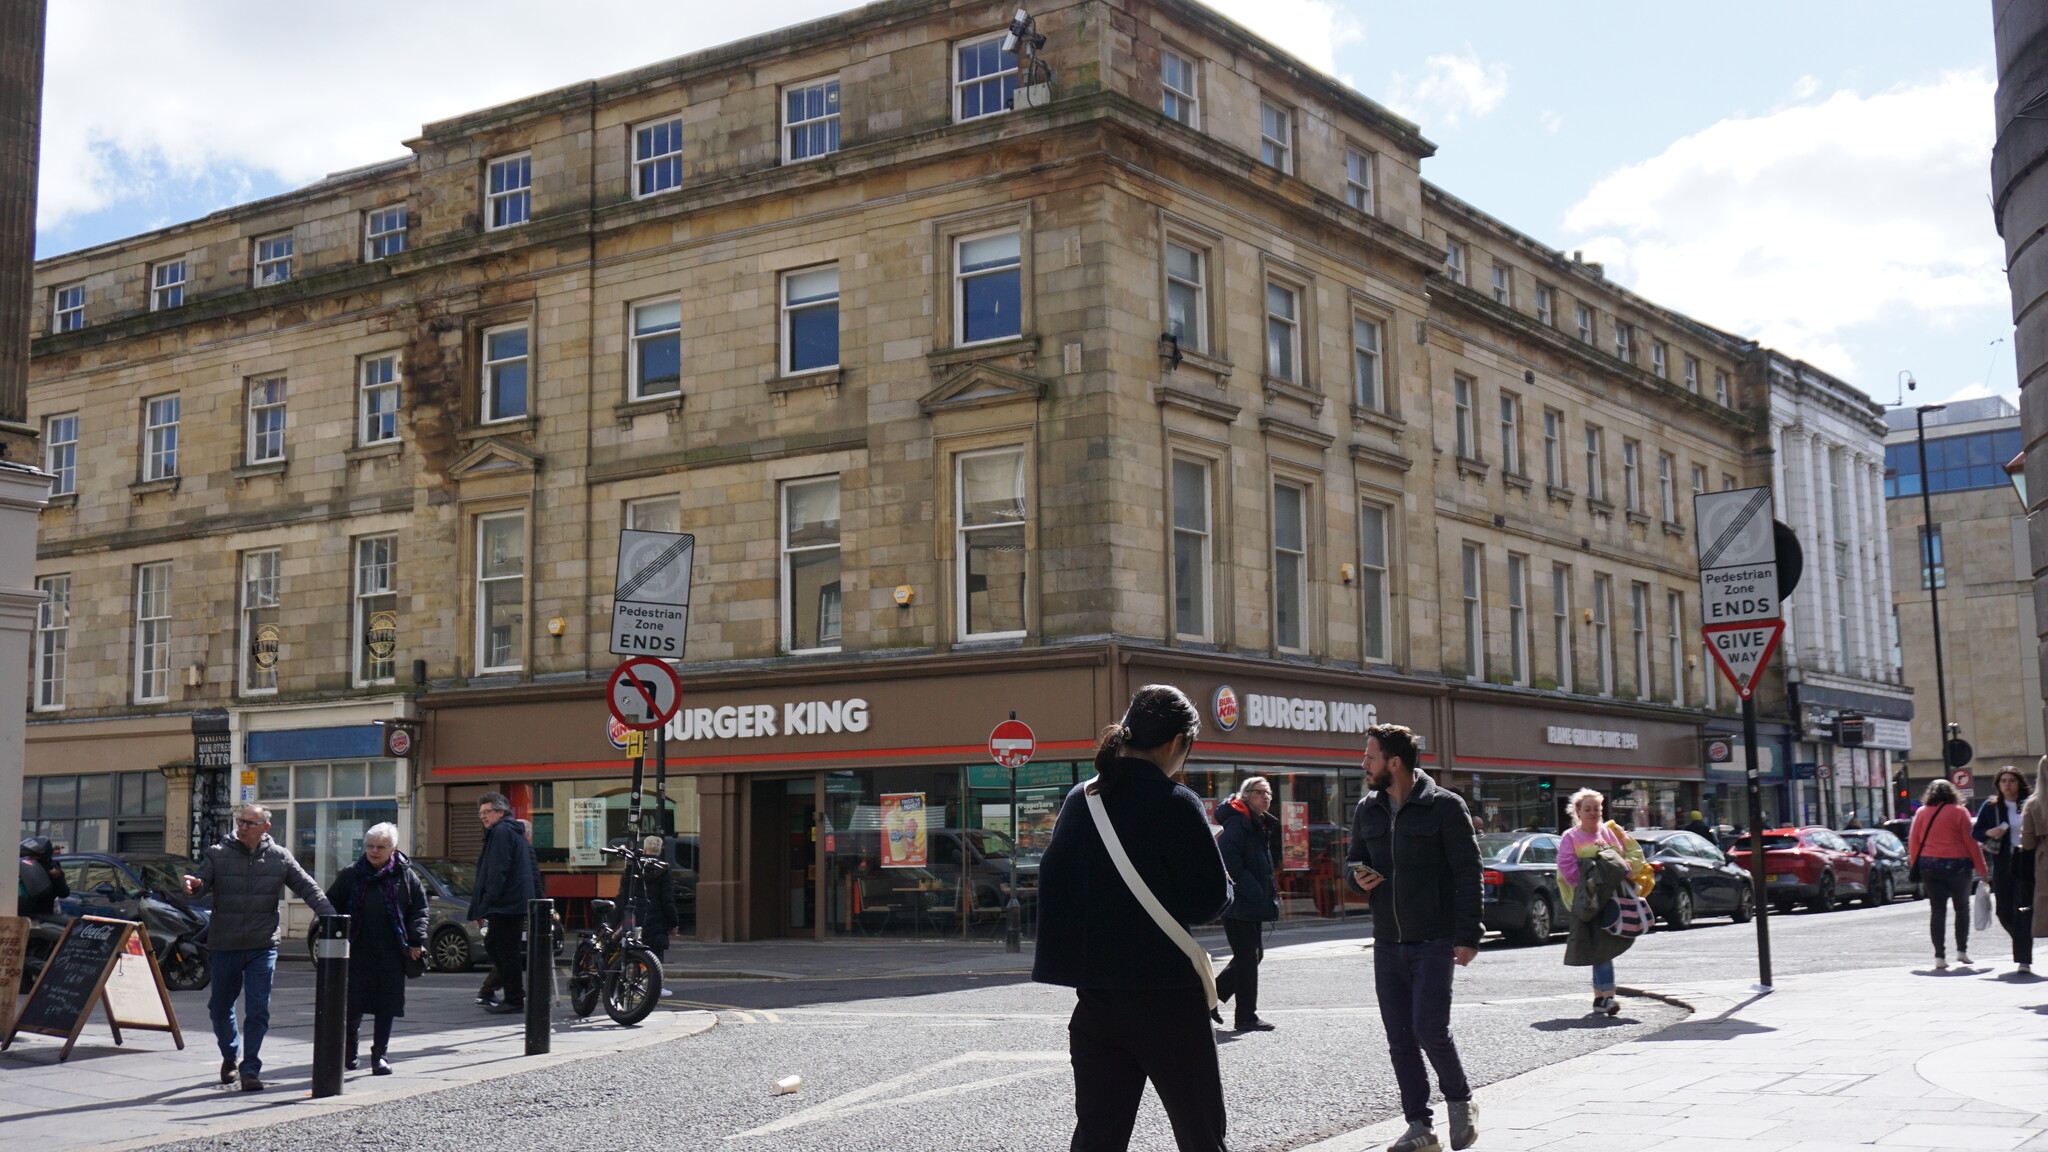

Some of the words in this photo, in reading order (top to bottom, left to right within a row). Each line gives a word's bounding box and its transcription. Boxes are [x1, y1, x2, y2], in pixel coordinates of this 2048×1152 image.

[1706, 569, 1772, 584] Pedestrian
[1724, 585, 1755, 595] Zone
[619, 605, 682, 619] Pedestrian
[1712, 598, 1770, 617] ENDS
[635, 619, 664, 631] Zone
[620, 634, 676, 651] ENDS
[1717, 631, 1765, 649] GIVE
[1728, 651, 1758, 663] WAY
[784, 699, 869, 735] KING
[1246, 694, 1327, 731] BURGER
[1330, 701, 1377, 733] KING
[0, 937, 19, 946] FFEE
